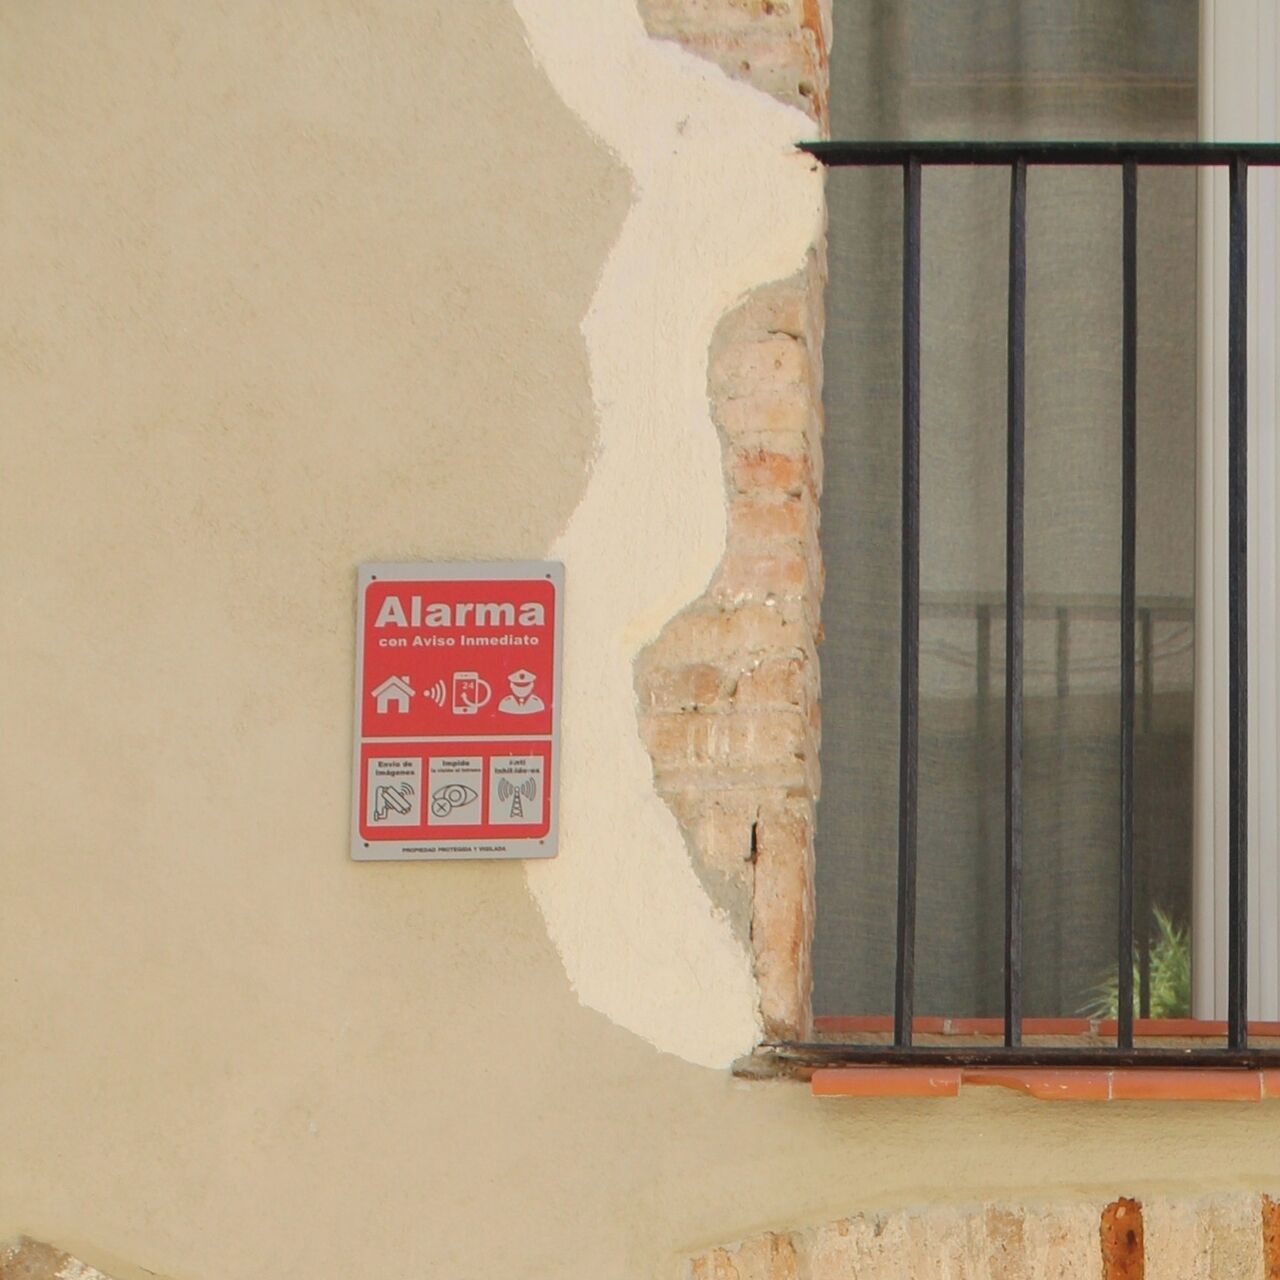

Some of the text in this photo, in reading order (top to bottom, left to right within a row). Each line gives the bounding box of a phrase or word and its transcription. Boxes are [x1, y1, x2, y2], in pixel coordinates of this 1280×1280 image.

[374, 595, 545, 628] Alarma
[379, 634, 539, 648] con Aviso Inmediato
[462, 681, 474, 690] 24
